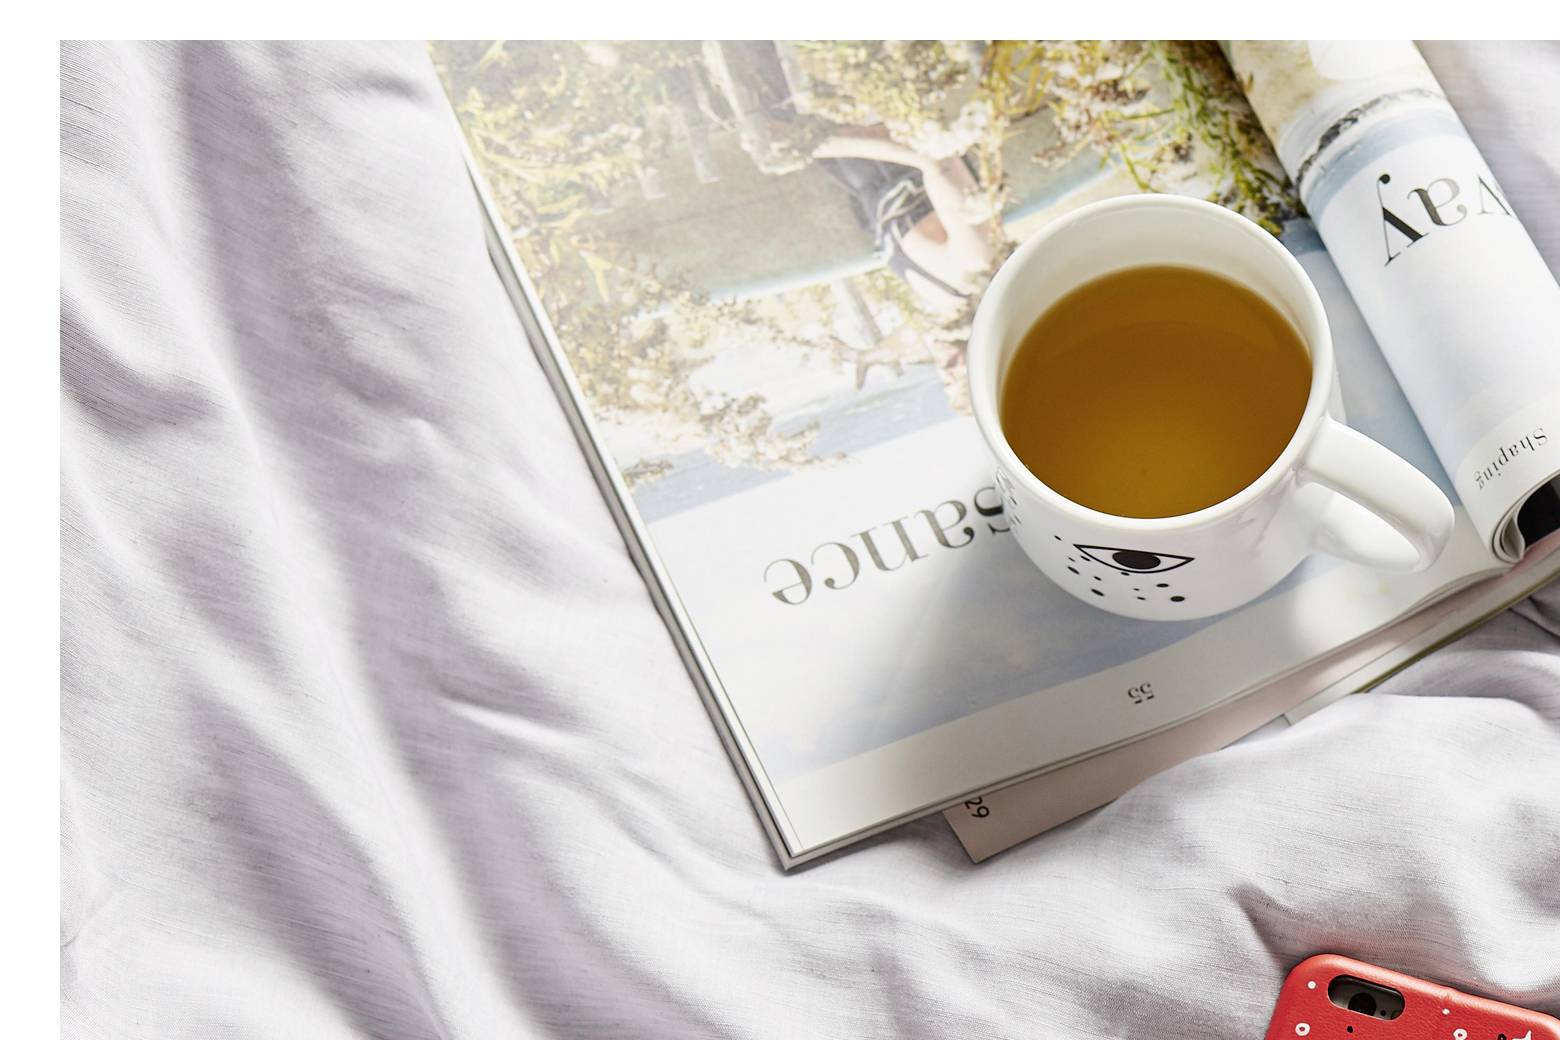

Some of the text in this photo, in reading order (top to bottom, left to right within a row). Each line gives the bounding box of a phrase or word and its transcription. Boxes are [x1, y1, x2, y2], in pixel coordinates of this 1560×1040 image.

[1474, 427, 1548, 490] Shaping
[1128, 682, 1154, 704] 55
[964, 795, 990, 818] 29
